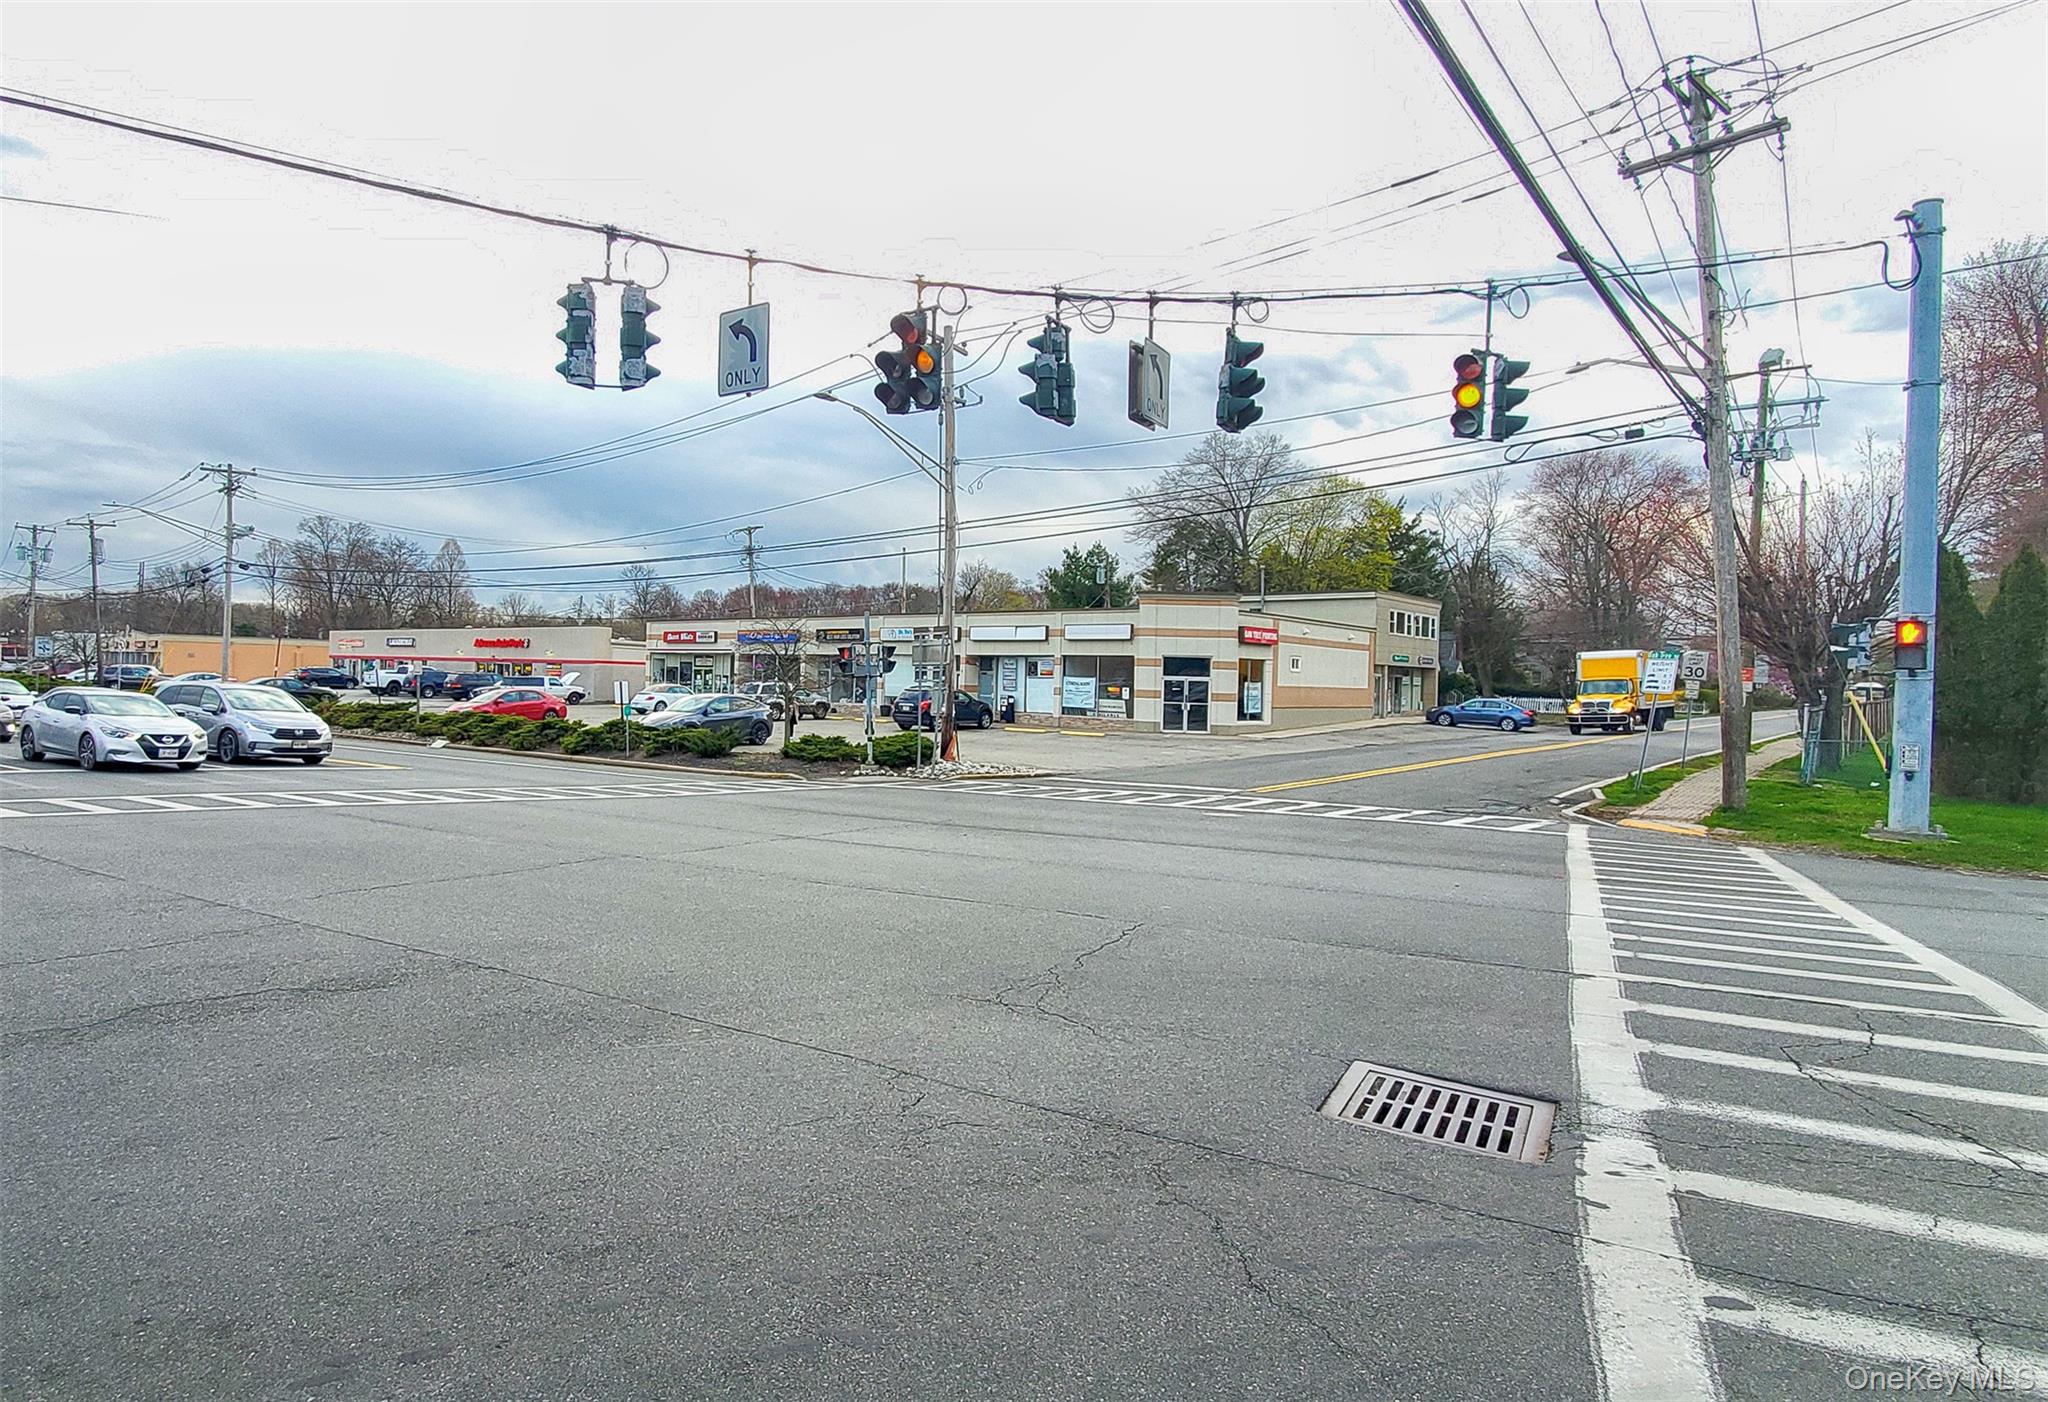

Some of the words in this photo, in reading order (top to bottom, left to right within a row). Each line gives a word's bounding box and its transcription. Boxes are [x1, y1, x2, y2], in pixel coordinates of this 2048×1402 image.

[725, 366, 761, 388] ONLY
[1146, 396, 1167, 420] ONLY
[1684, 666, 1705, 679] 30
